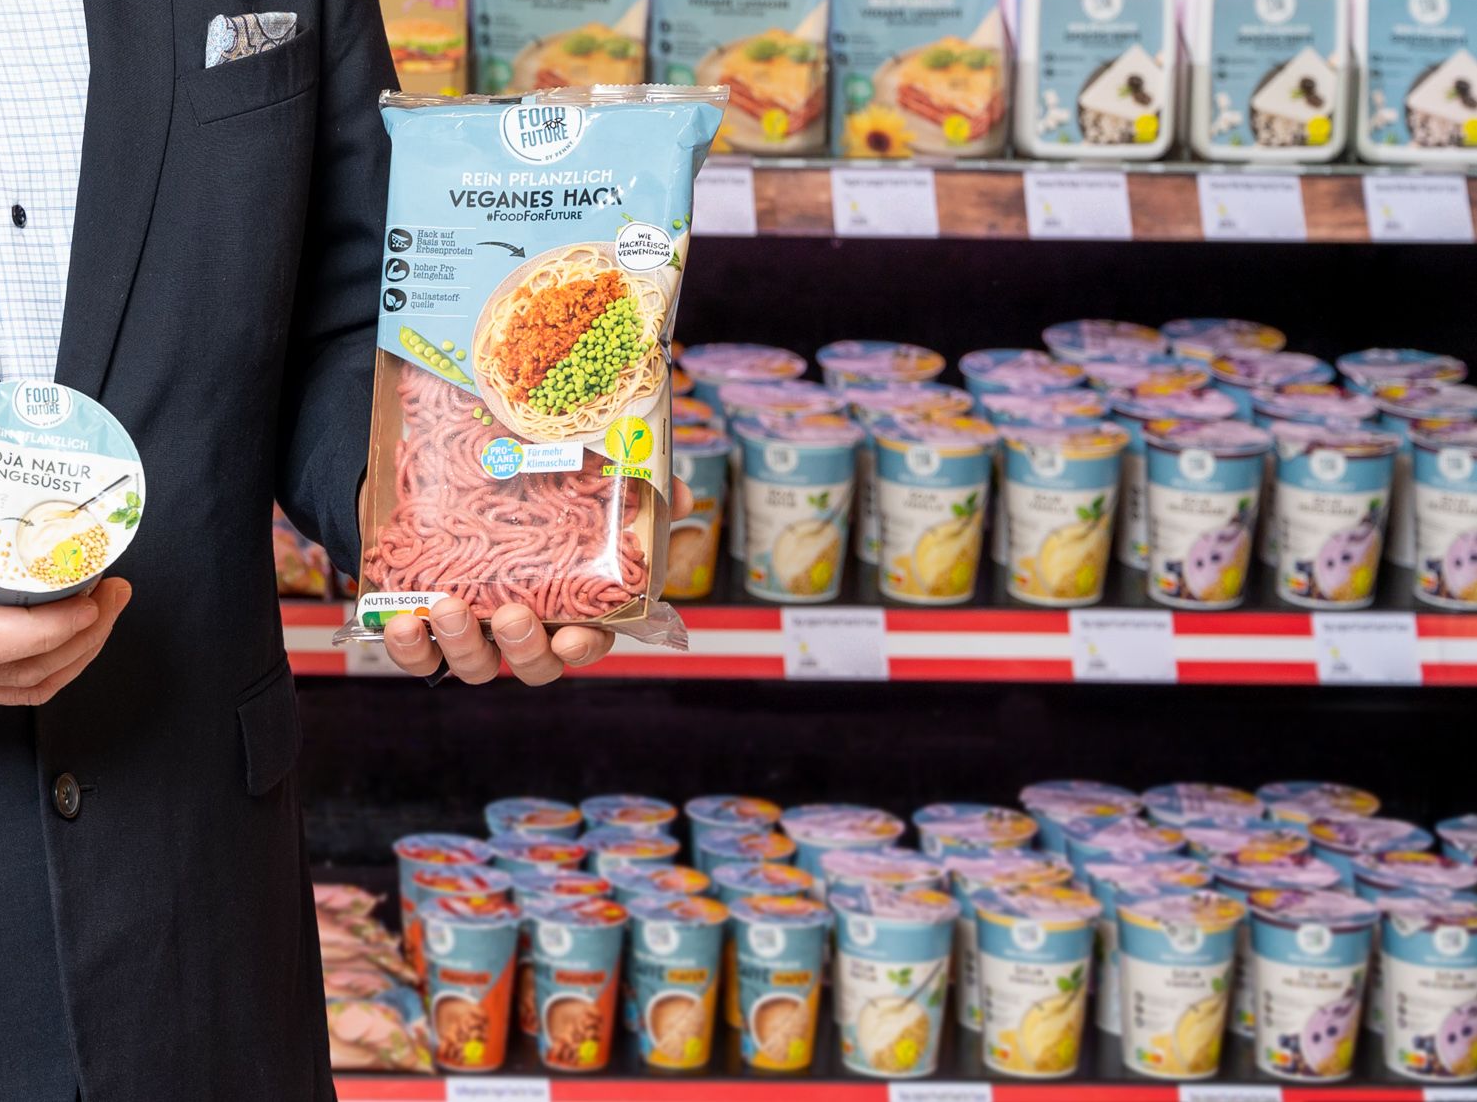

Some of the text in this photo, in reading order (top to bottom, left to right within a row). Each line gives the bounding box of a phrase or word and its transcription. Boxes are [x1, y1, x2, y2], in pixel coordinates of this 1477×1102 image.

[518, 106, 566, 129] FOOD
[520, 125, 569, 148] FUTURE
[449, 187, 623, 208] VEGANES HACK
[417, 230, 454, 239] Hack auf
[417, 238, 456, 247] Basis von
[619, 239, 670, 250] HACKFLEISCH
[415, 245, 474, 257] Erbsenprotein
[618, 247, 671, 258] VERWENDBAR
[414, 263, 457, 273] hoher Pro-
[413, 271, 455, 282] teingehalt
[410, 300, 435, 310] quelle
[25, 387, 59, 403] FOOD
[528, 447, 563, 457] Für mehr
[32, 458, 92, 479] NATUR
[493, 463, 515, 474] INFO
[526, 458, 577, 469] Klimaschutz
[604, 466, 652, 479] VEGAN
[364, 596, 429, 606] NUTRI-SCORE
